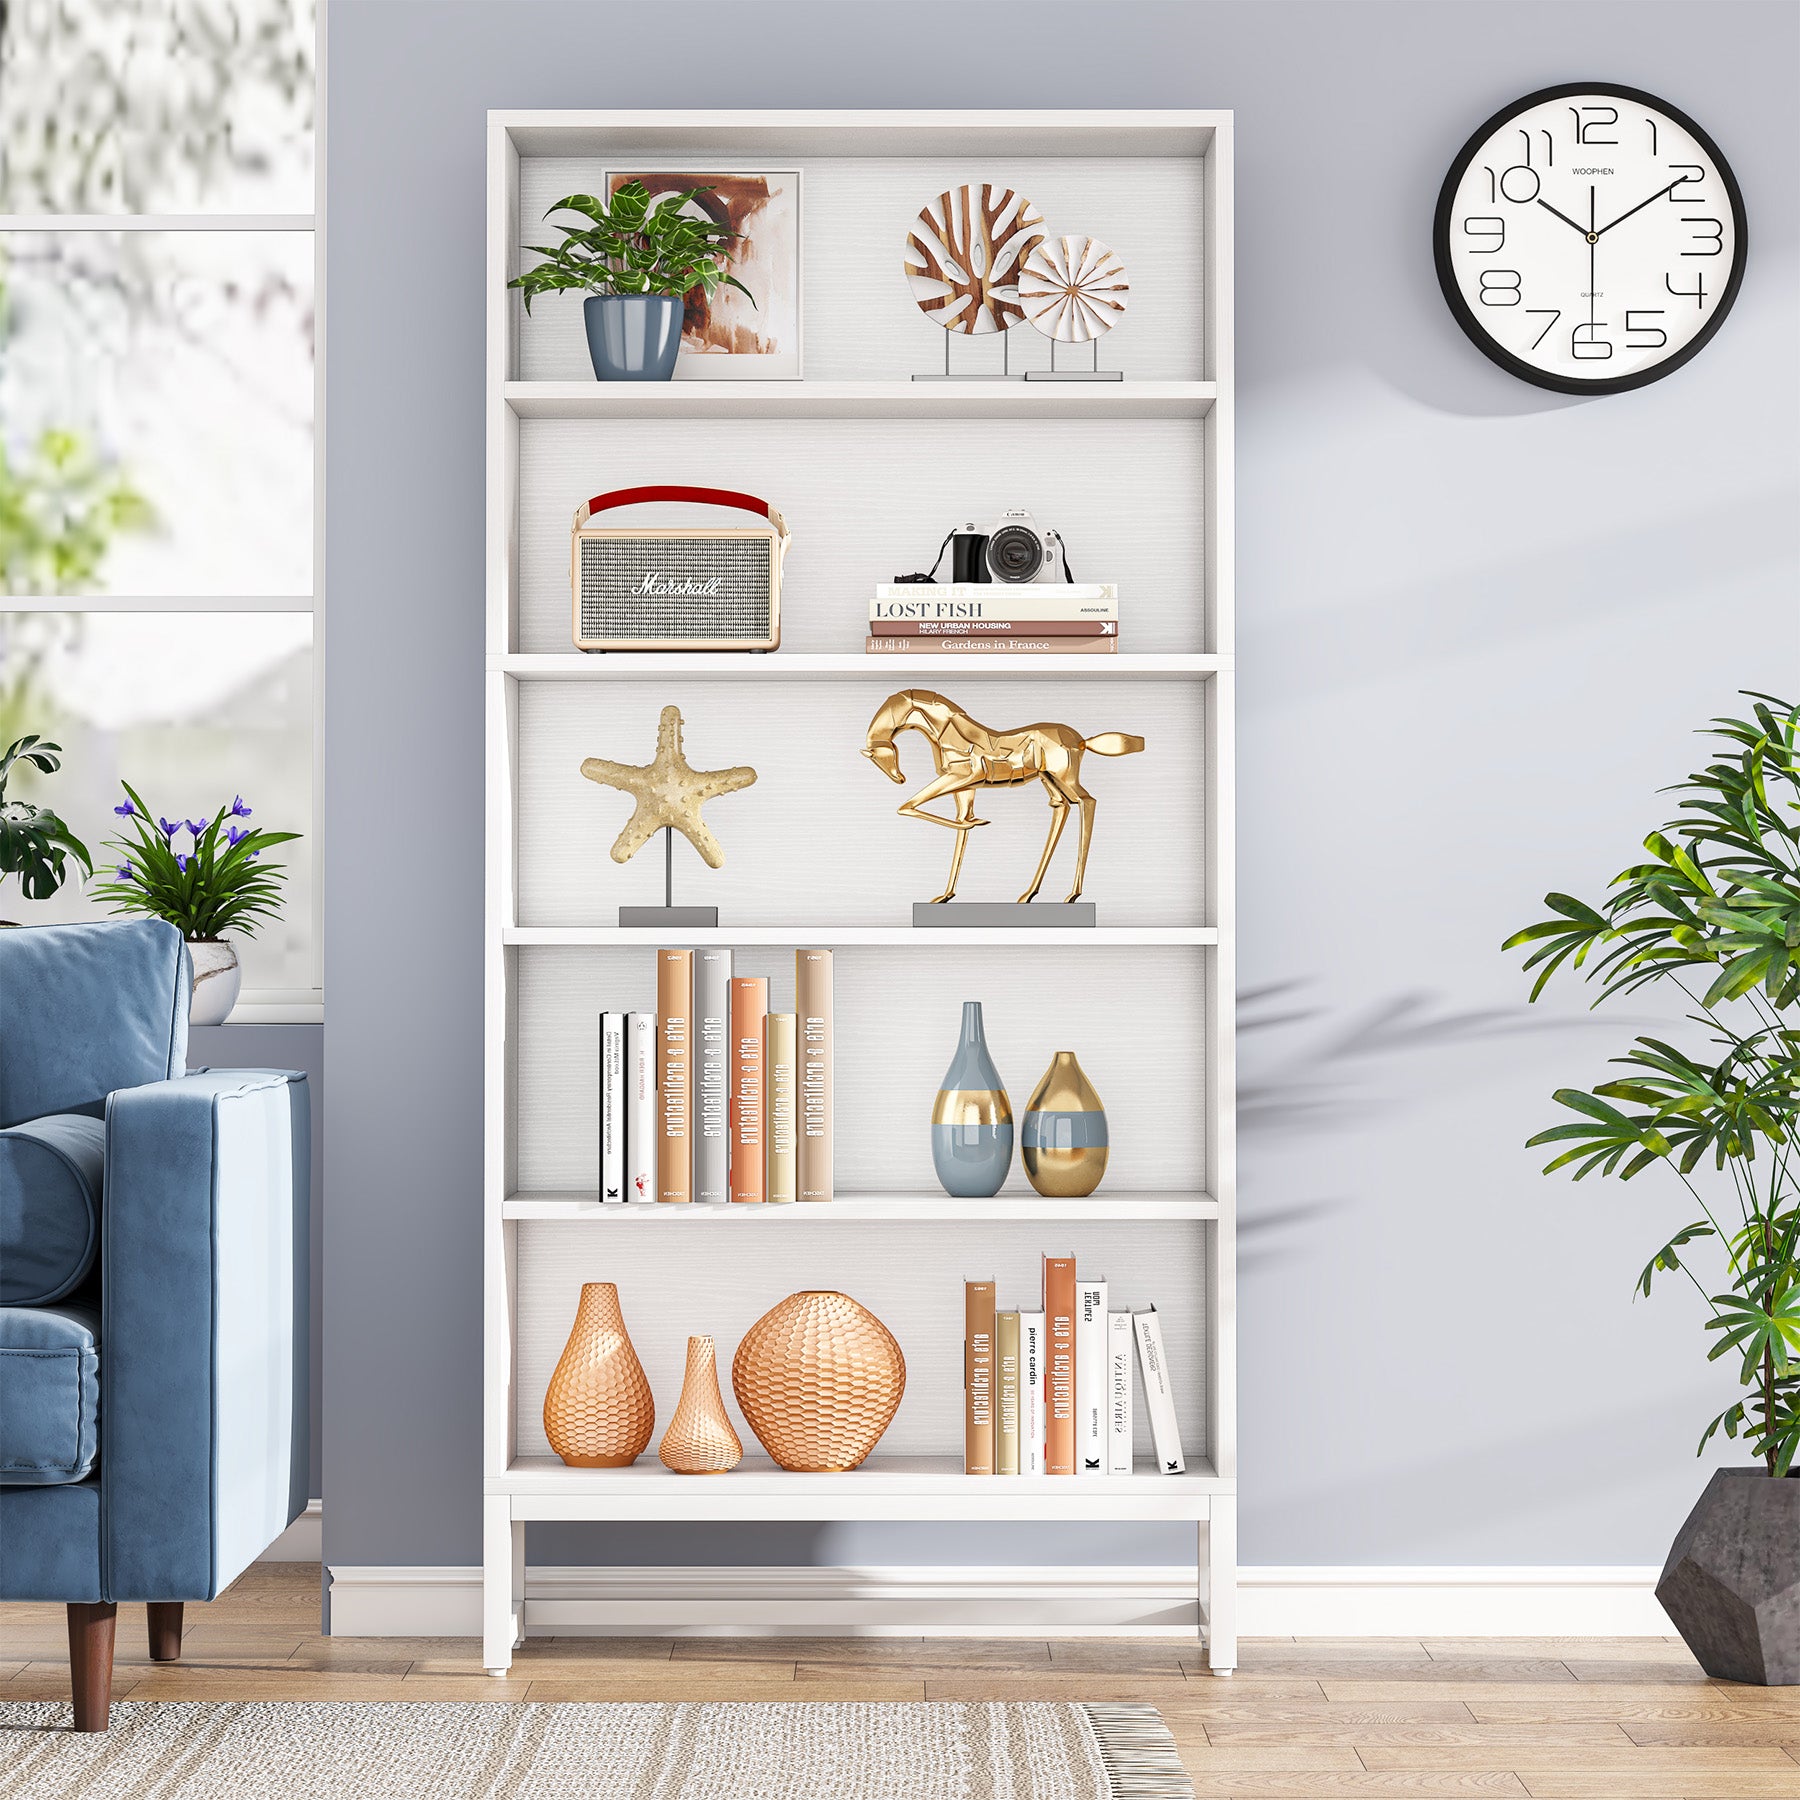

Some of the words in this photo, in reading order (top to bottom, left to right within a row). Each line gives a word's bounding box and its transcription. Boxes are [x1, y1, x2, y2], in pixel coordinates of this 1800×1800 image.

[1568, 107, 1619, 144] 12
[1645, 118, 1657, 156] 1
[1519, 129, 1553, 167] 11
[1484, 165, 1541, 204] 10
[1572, 167, 1615, 175] WOOPHEN
[1668, 164, 1706, 203] 2
[1464, 216, 1505, 254] 9
[1680, 217, 1724, 257] 3
[1479, 269, 1522, 307] 8
[1666, 272, 1709, 310] 4
[1525, 309, 1562, 351] 7
[1572, 323, 1613, 360] 6
[1626, 310, 1668, 348] 5
[631, 572, 721, 595] Marshall
[887, 586, 950, 597] MAKING
[952, 586, 967, 597] IT
[876, 603, 931, 618] LOST
[936, 603, 983, 618] FISH
[941, 640, 991, 650] Gardens
[994, 640, 1006, 650] in
[1009, 640, 1050, 650] France
[1028, 1327, 1036, 1354] pierre
